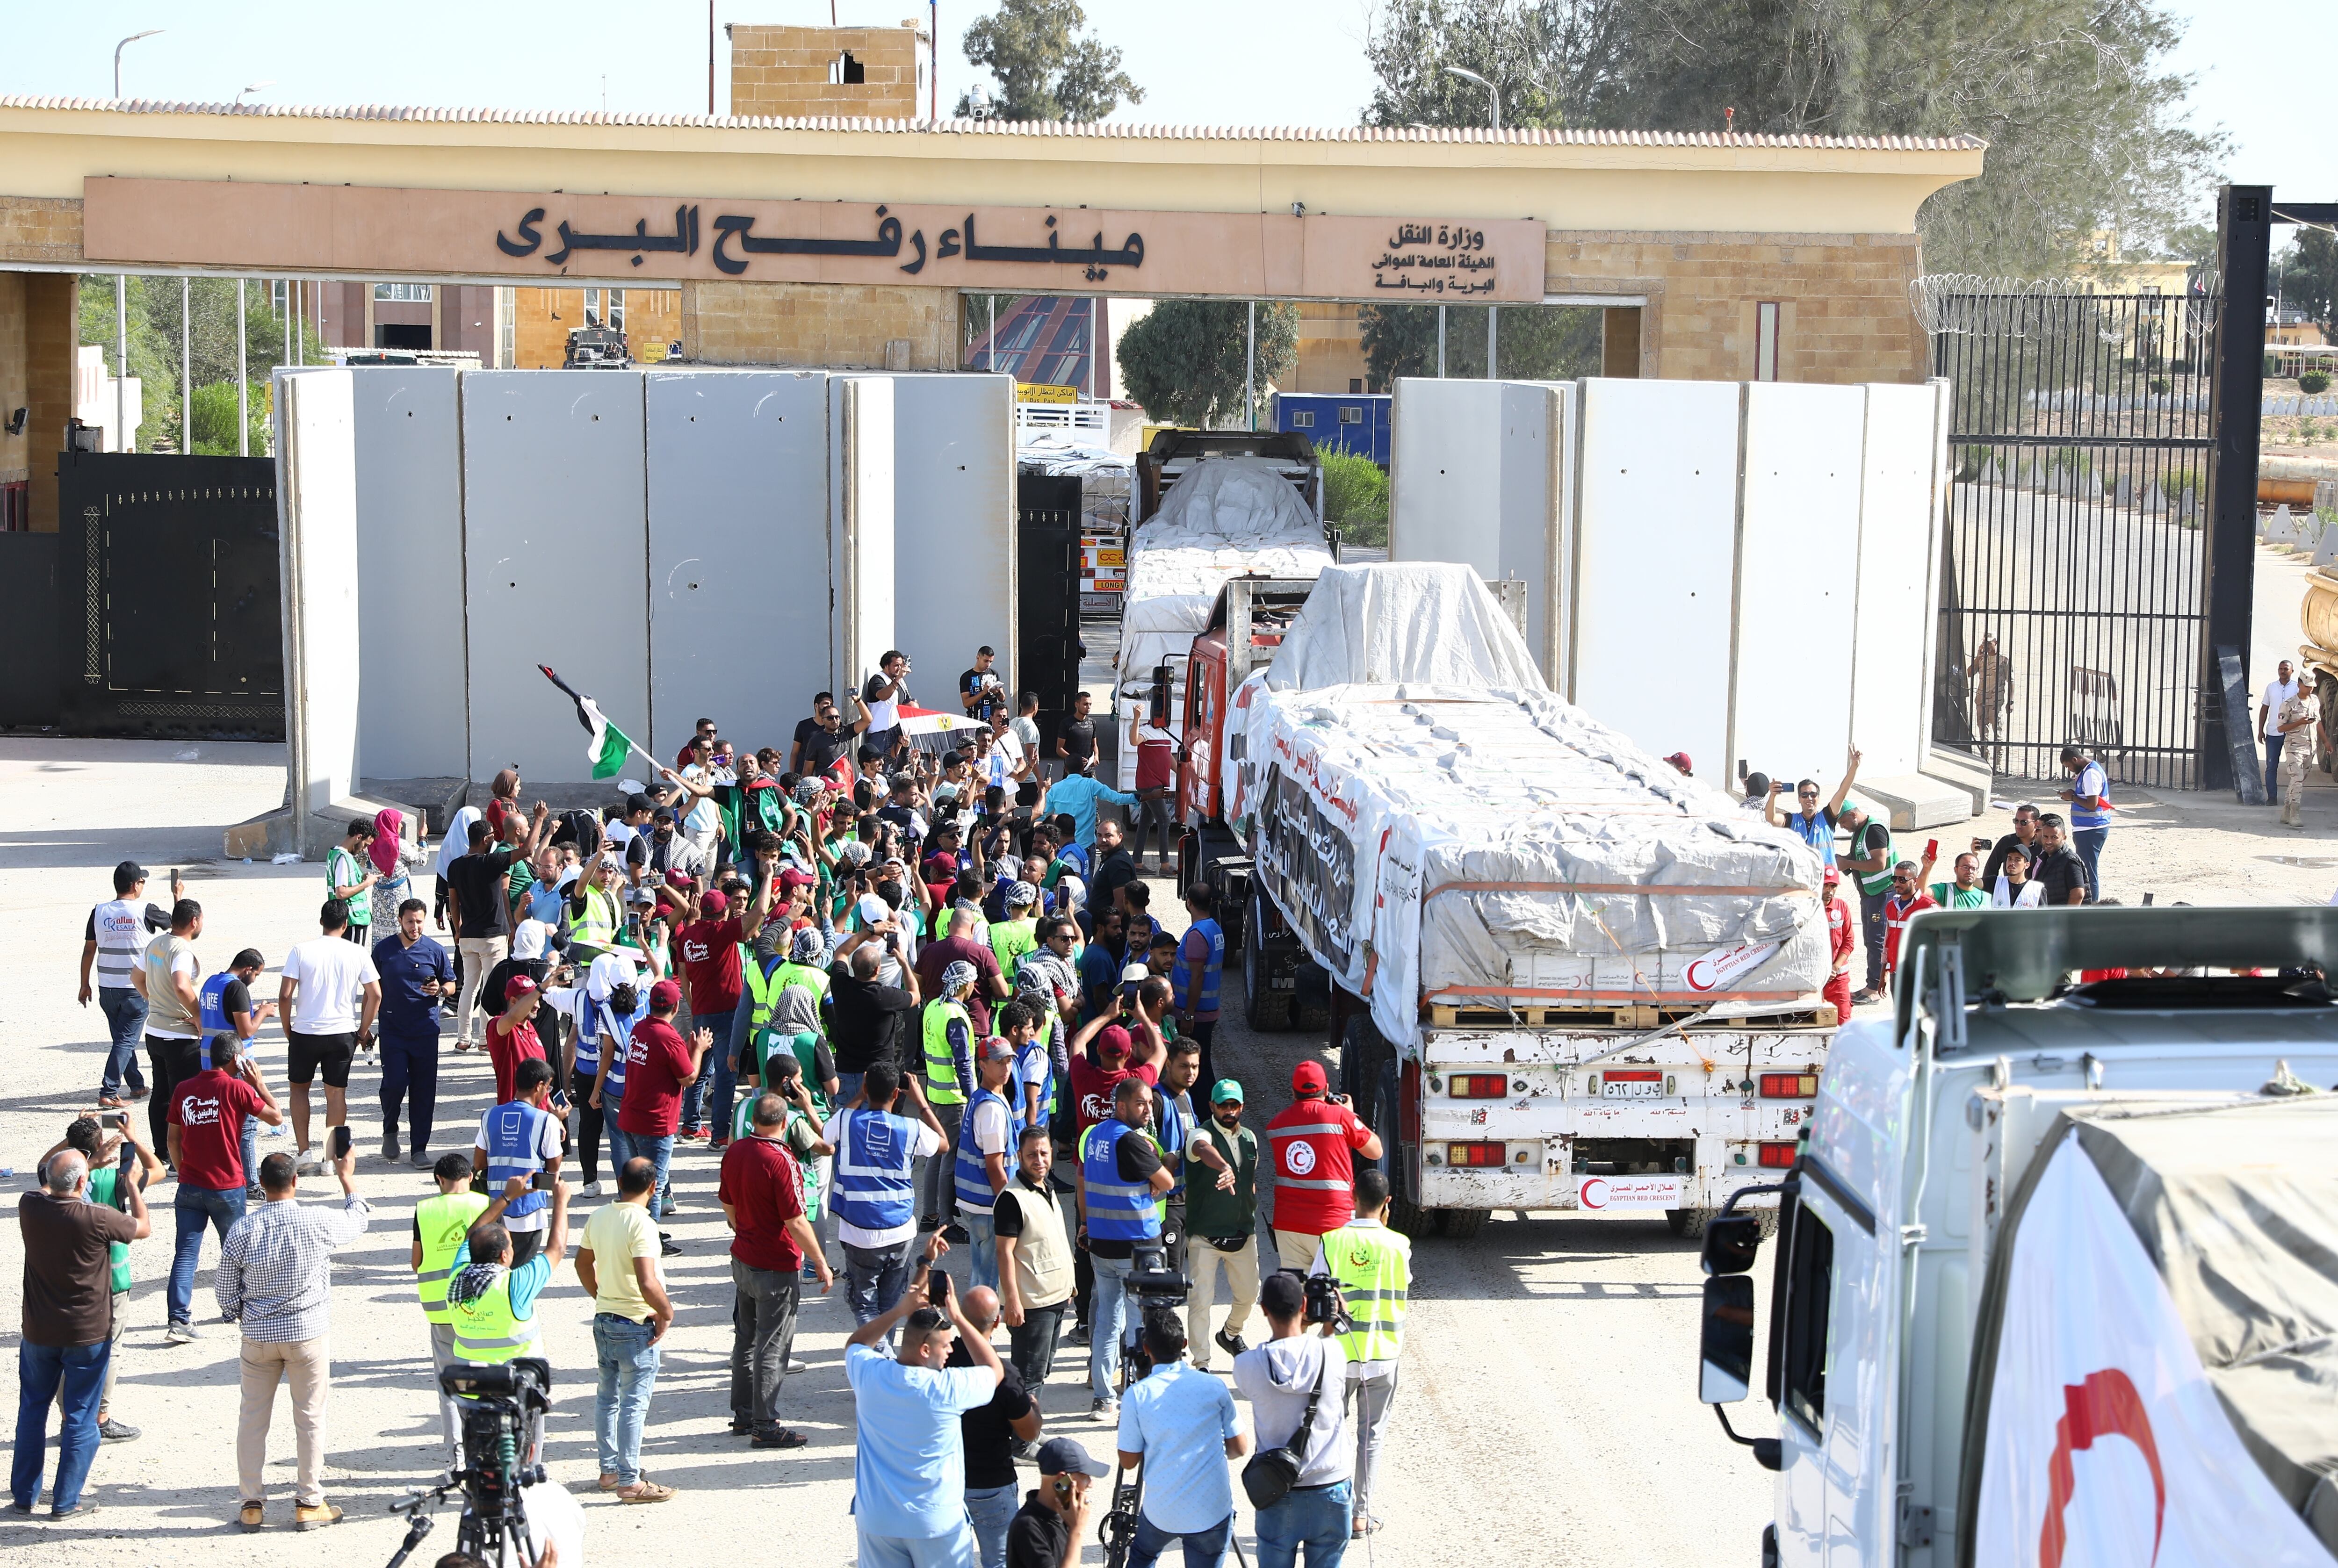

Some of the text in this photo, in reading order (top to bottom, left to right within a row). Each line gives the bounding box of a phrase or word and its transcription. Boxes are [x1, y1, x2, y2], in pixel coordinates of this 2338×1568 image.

[713, 204, 926, 276] رفح
[1389, 223, 1484, 251] وزارة النقل
[938, 213, 1144, 281] ميناء
[1417, 254, 1455, 268] العامة
[1458, 253, 1494, 272] الهيئة
[1375, 273, 1494, 295] البرية والجافة
[1038, 388, 1055, 396] انتظار
[1716, 959, 1739, 975] EGYPTIAN
[1739, 953, 1750, 962] RED
[1608, 1083, 1627, 1096] ٥٦٢
[1634, 1084, 1642, 1095] ل
[1644, 1085, 1651, 1095] و
[197, 1096, 219, 1107] مؤسسة
[1634, 1182, 1656, 1193] الأحمر
[1657, 1183, 1677, 1193] الهلال
